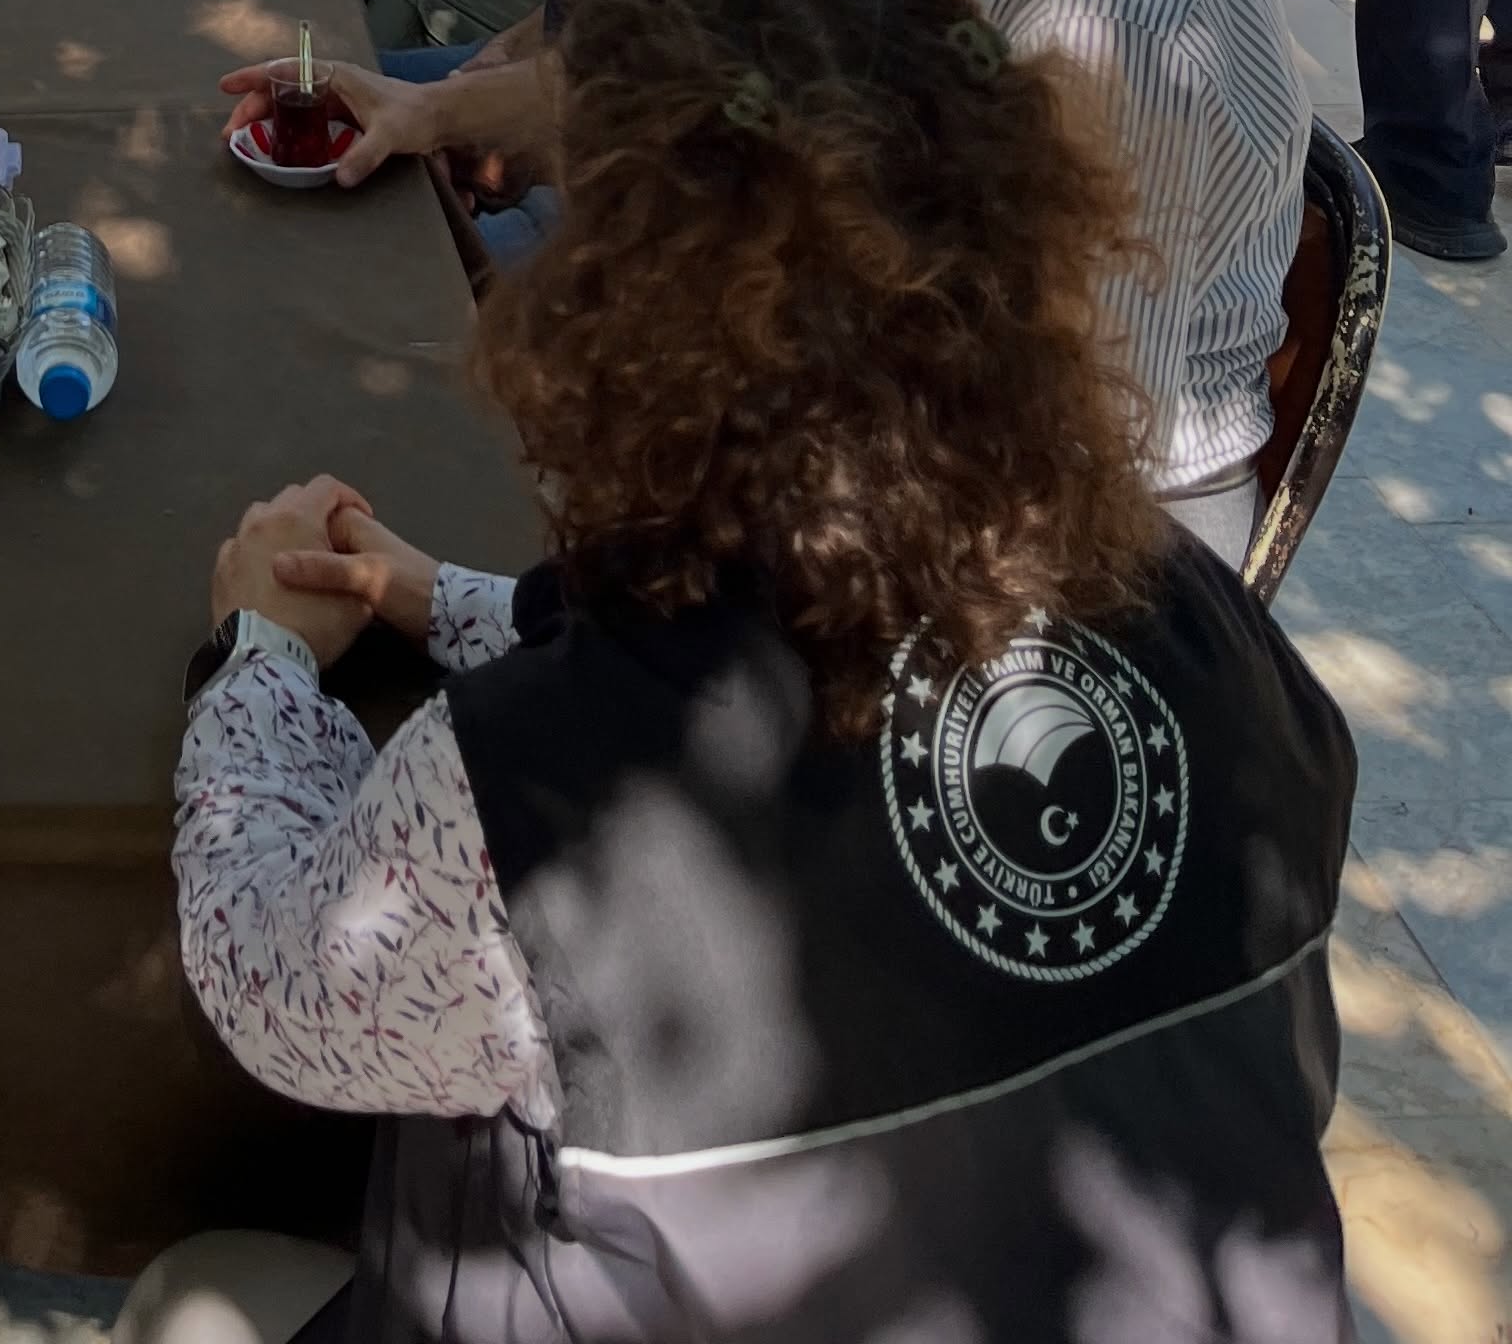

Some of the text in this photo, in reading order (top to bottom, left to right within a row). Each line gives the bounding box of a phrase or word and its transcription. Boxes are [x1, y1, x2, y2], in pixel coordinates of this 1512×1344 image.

[1050, 653, 1076, 681] VE
[1080, 673, 1135, 756] ORMAN
[943, 673, 984, 844] CUMHURİYETİ
[1088, 763, 1139, 888] BAKANLIĞI
[972, 844, 1055, 908] TÜRKİYE
